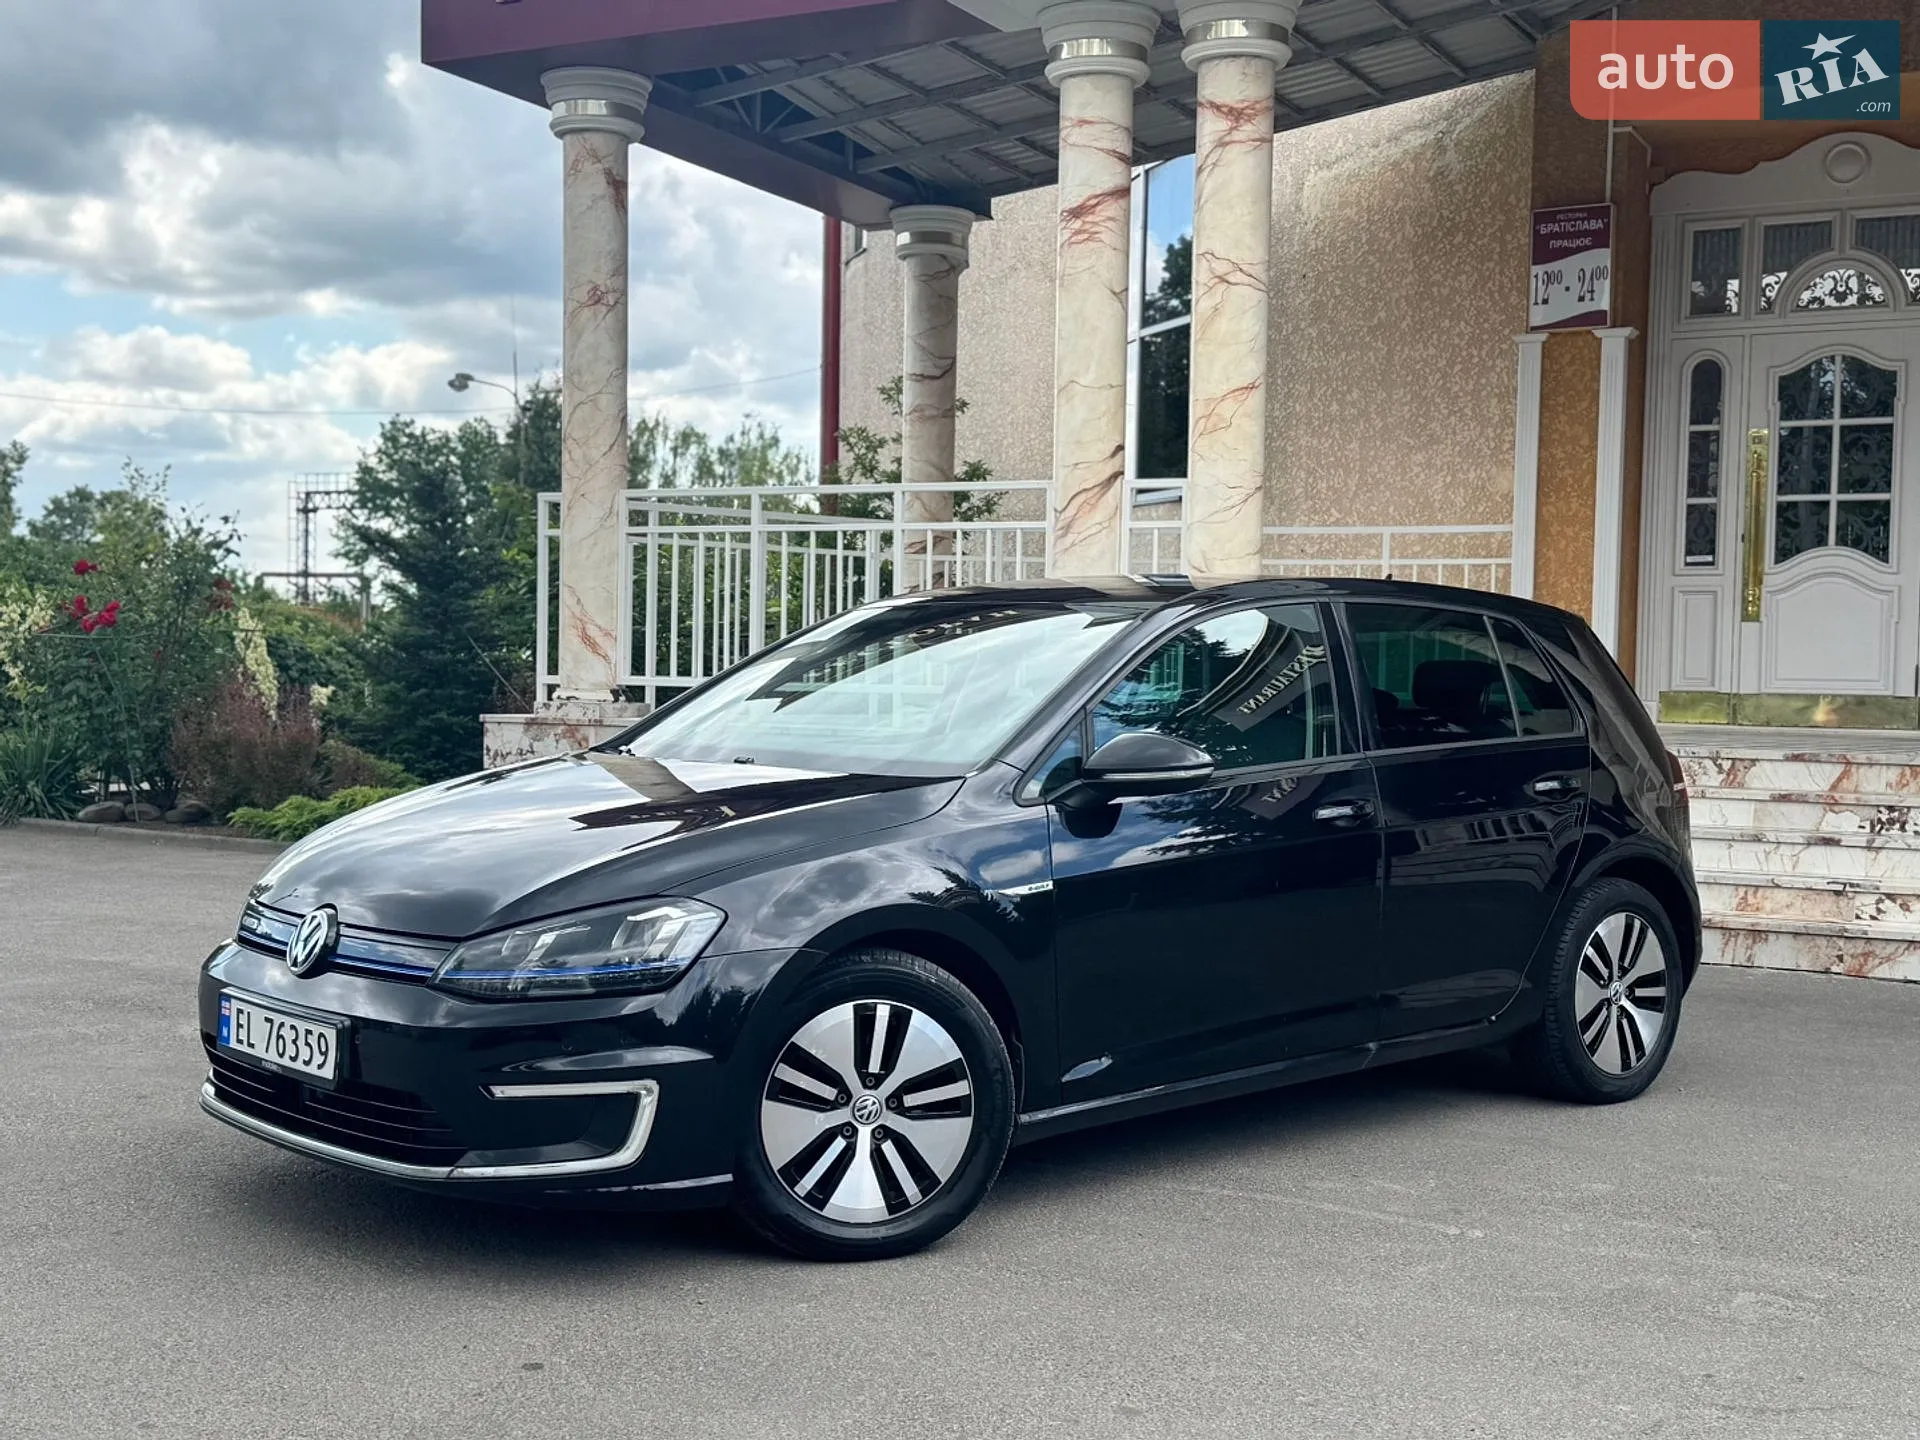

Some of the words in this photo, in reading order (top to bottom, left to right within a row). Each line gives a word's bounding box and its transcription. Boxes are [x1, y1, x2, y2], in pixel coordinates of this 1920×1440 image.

[1549, 237, 1593, 249] ПРАЦЮЄ
[235, 1007, 256, 1050] EL
[263, 1016, 330, 1071] 76359
